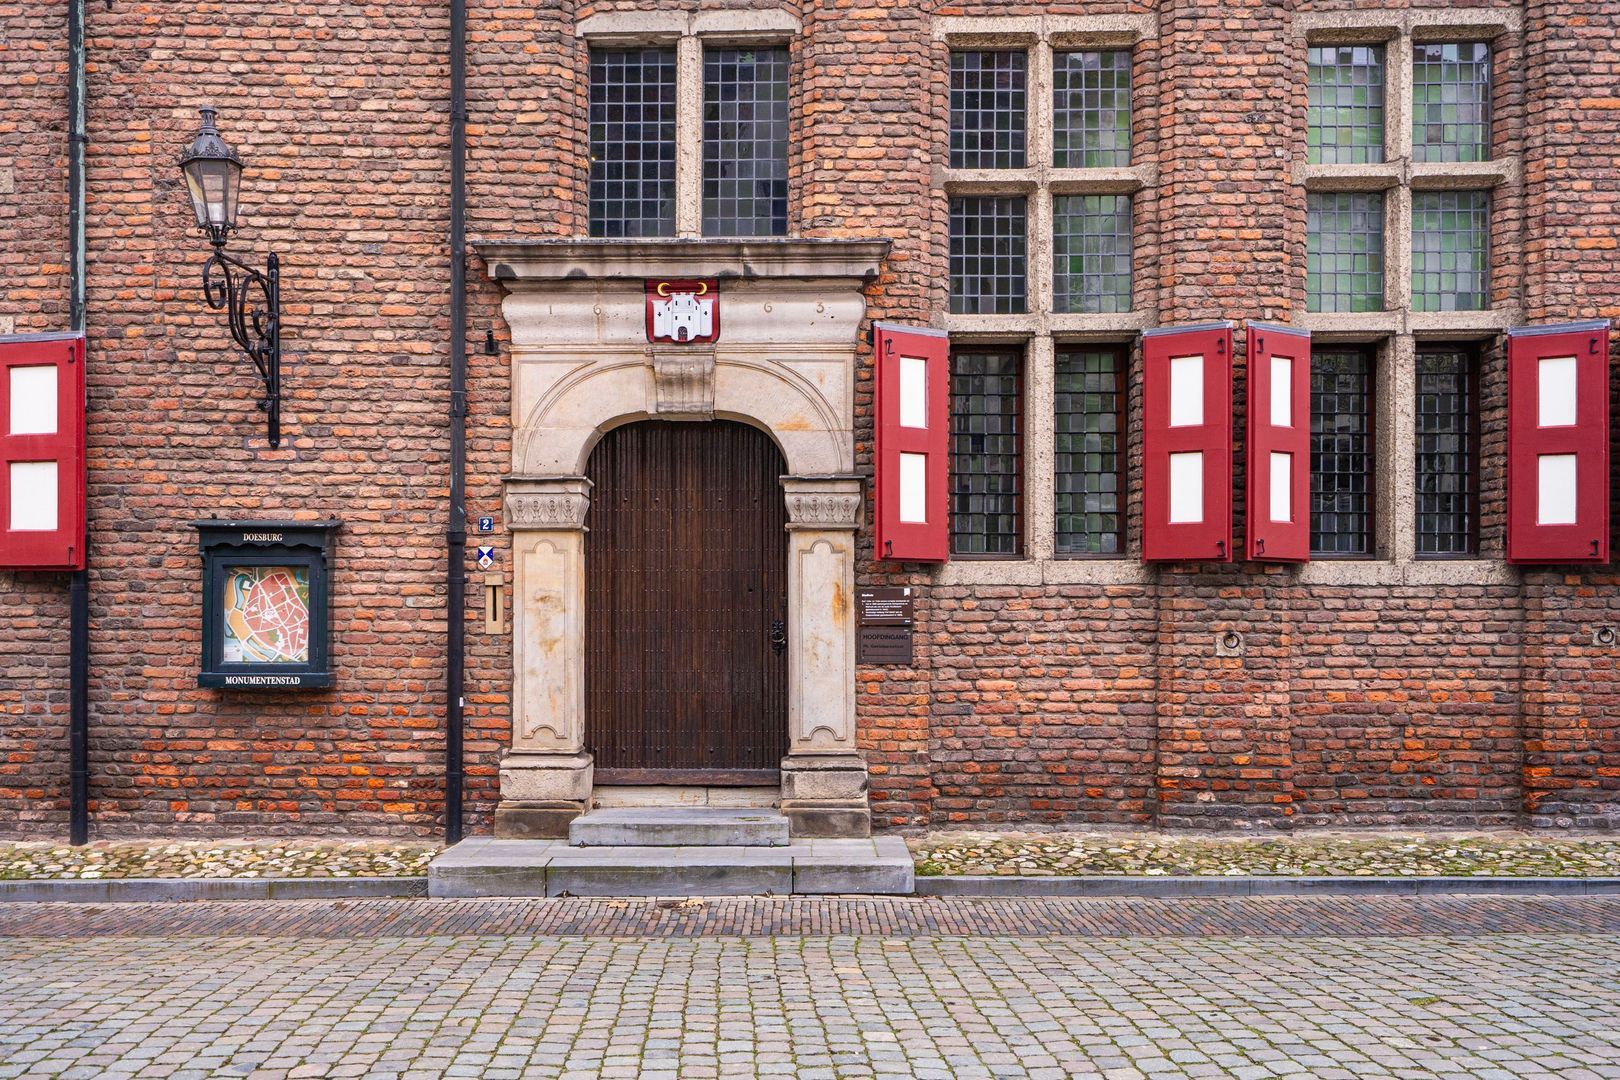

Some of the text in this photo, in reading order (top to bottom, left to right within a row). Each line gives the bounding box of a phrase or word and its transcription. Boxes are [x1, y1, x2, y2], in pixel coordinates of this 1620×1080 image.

[763, 303, 773, 313] 6
[816, 302, 825, 314] 3
[482, 519, 489, 530] 2
[243, 533, 283, 541] DOESBURG
[225, 676, 301, 685] MONUMENTENSTAD
